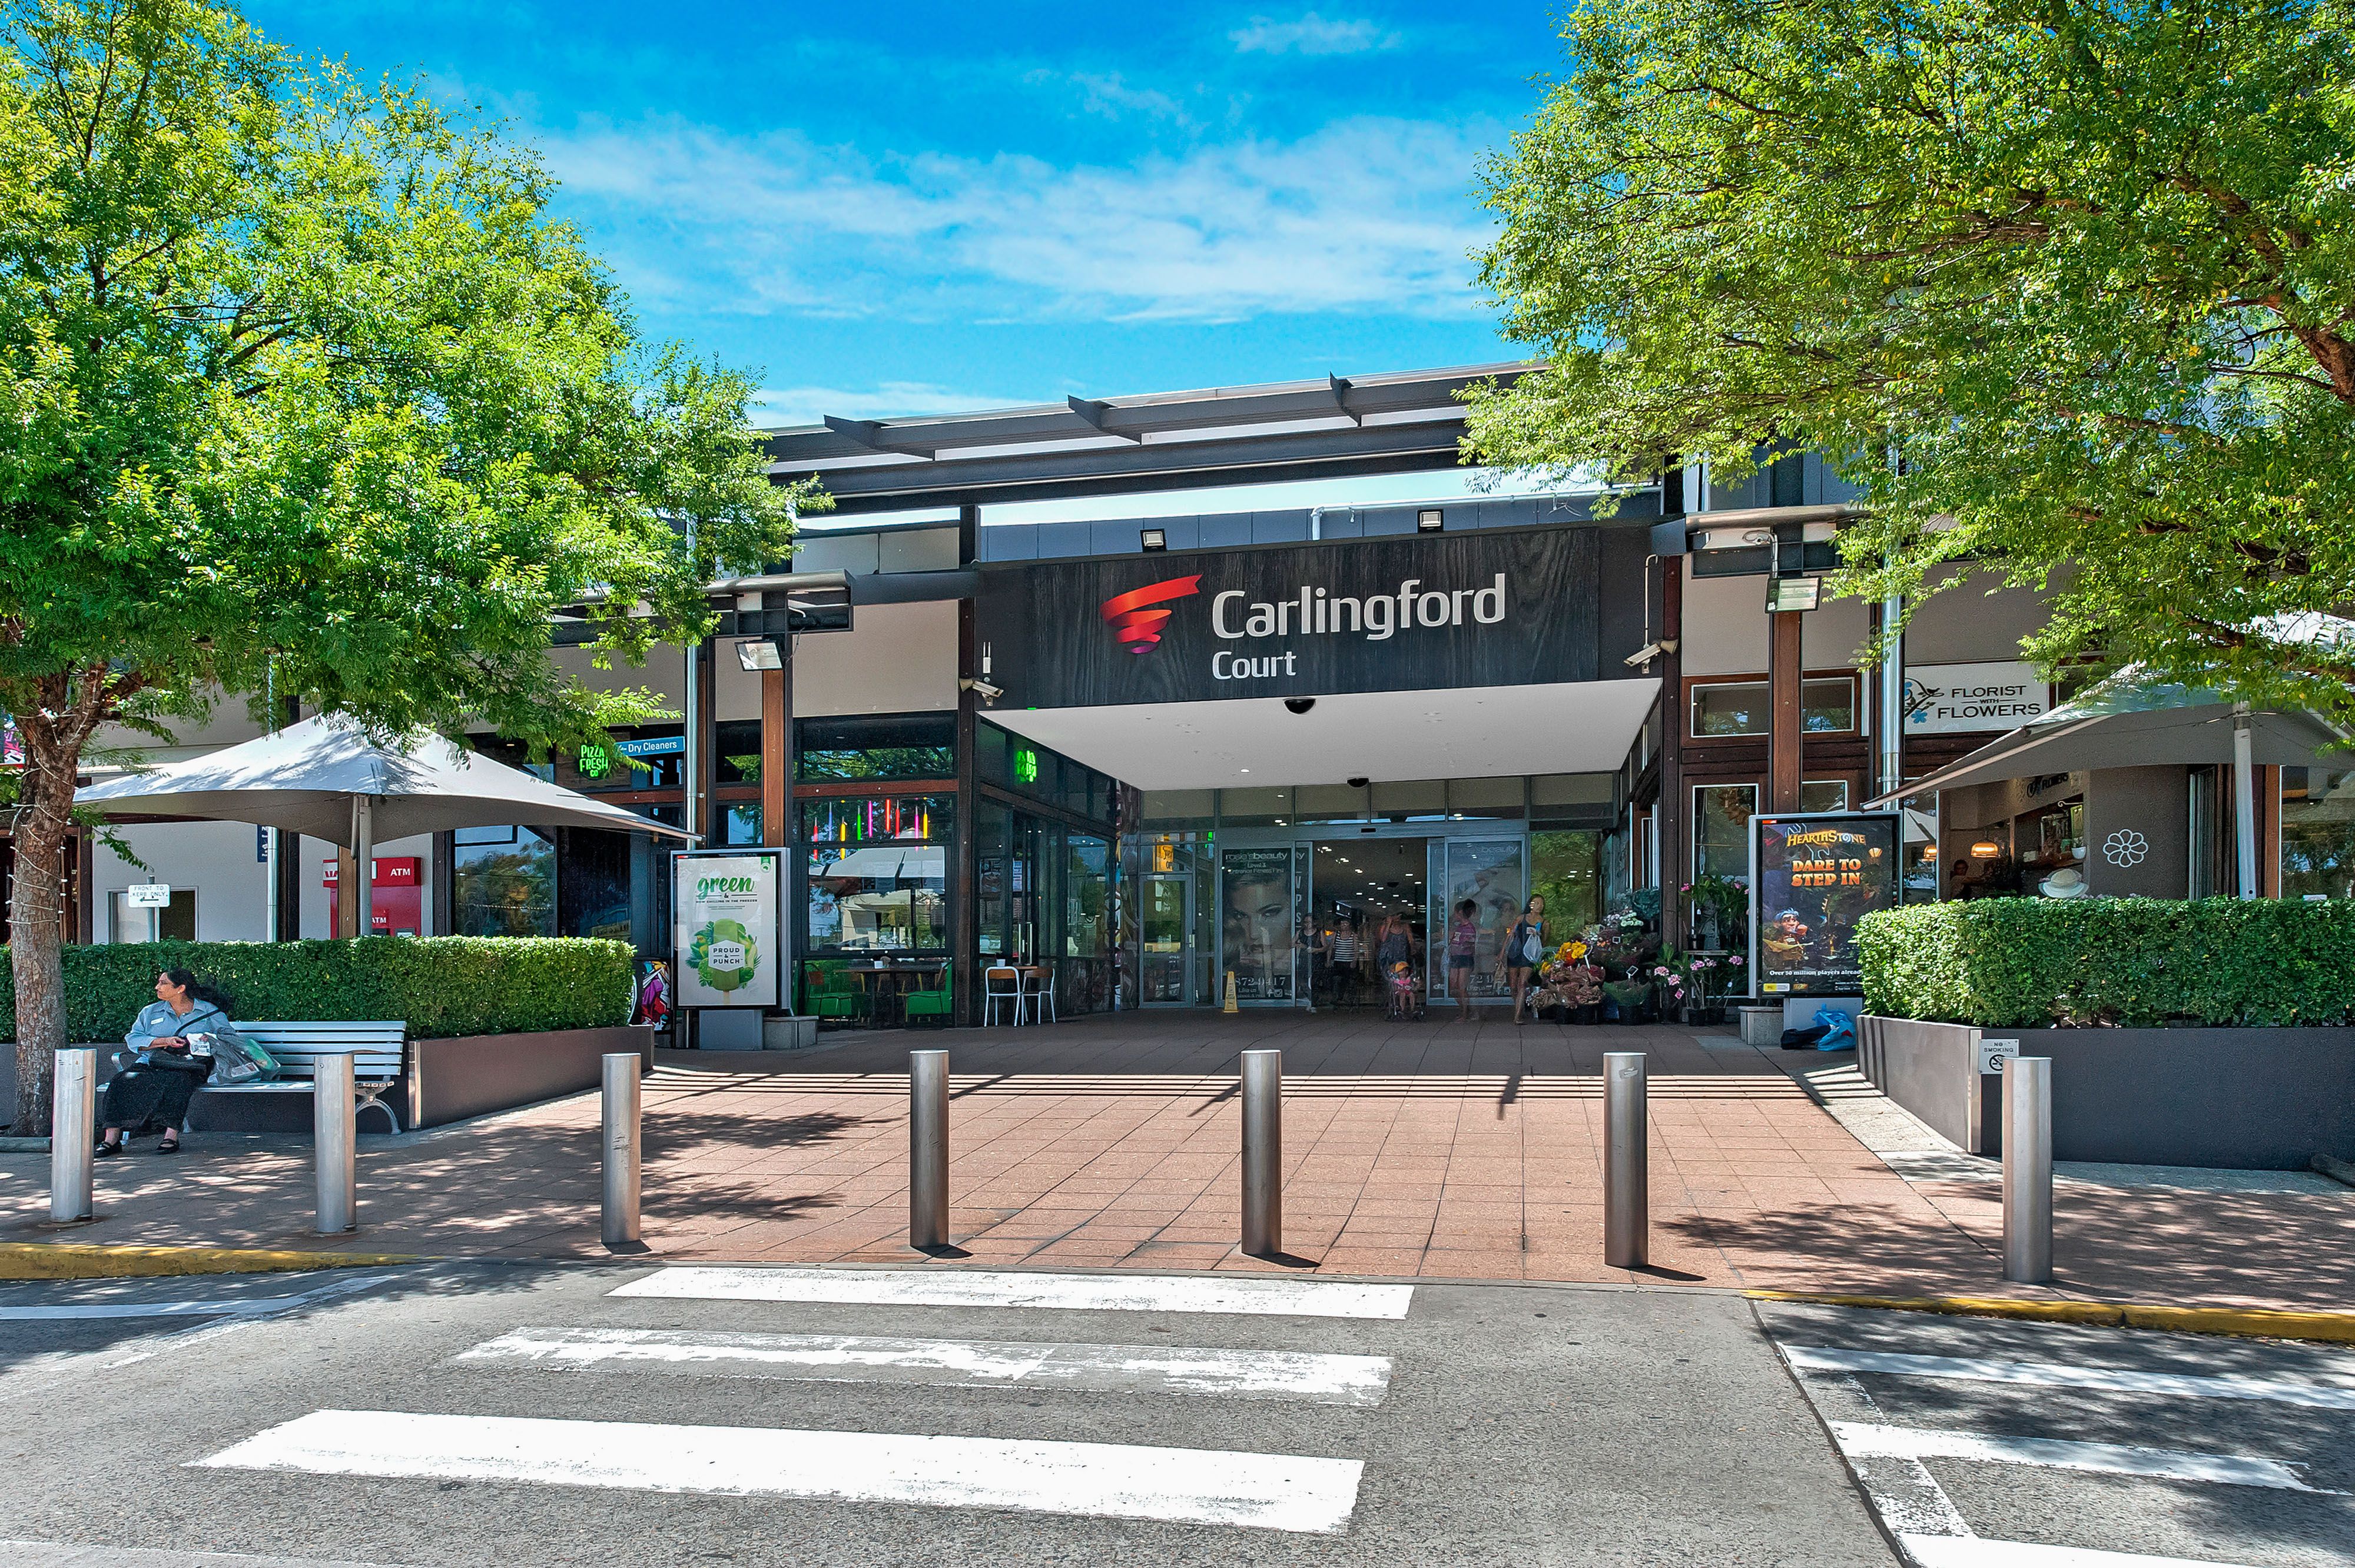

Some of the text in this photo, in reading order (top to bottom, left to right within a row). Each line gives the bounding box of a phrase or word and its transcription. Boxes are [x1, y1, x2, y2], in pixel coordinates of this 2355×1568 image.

[1212, 573, 1505, 640] Carlingford
[1212, 651, 1297, 680] Court
[1952, 685, 2026, 698] FLORIST
[1938, 703, 2041, 719] FLOWERS
[581, 744, 605, 758] PIZZA
[628, 741, 677, 753] Dry Cleaners
[579, 757, 609, 772] FRESH
[1787, 830, 1866, 848] HEARTHSTONE
[390, 868, 410, 876] ATM
[1792, 858, 1862, 872] DARE TO
[1791, 872, 1860, 887] STEP IN
[697, 877, 755, 900] green
